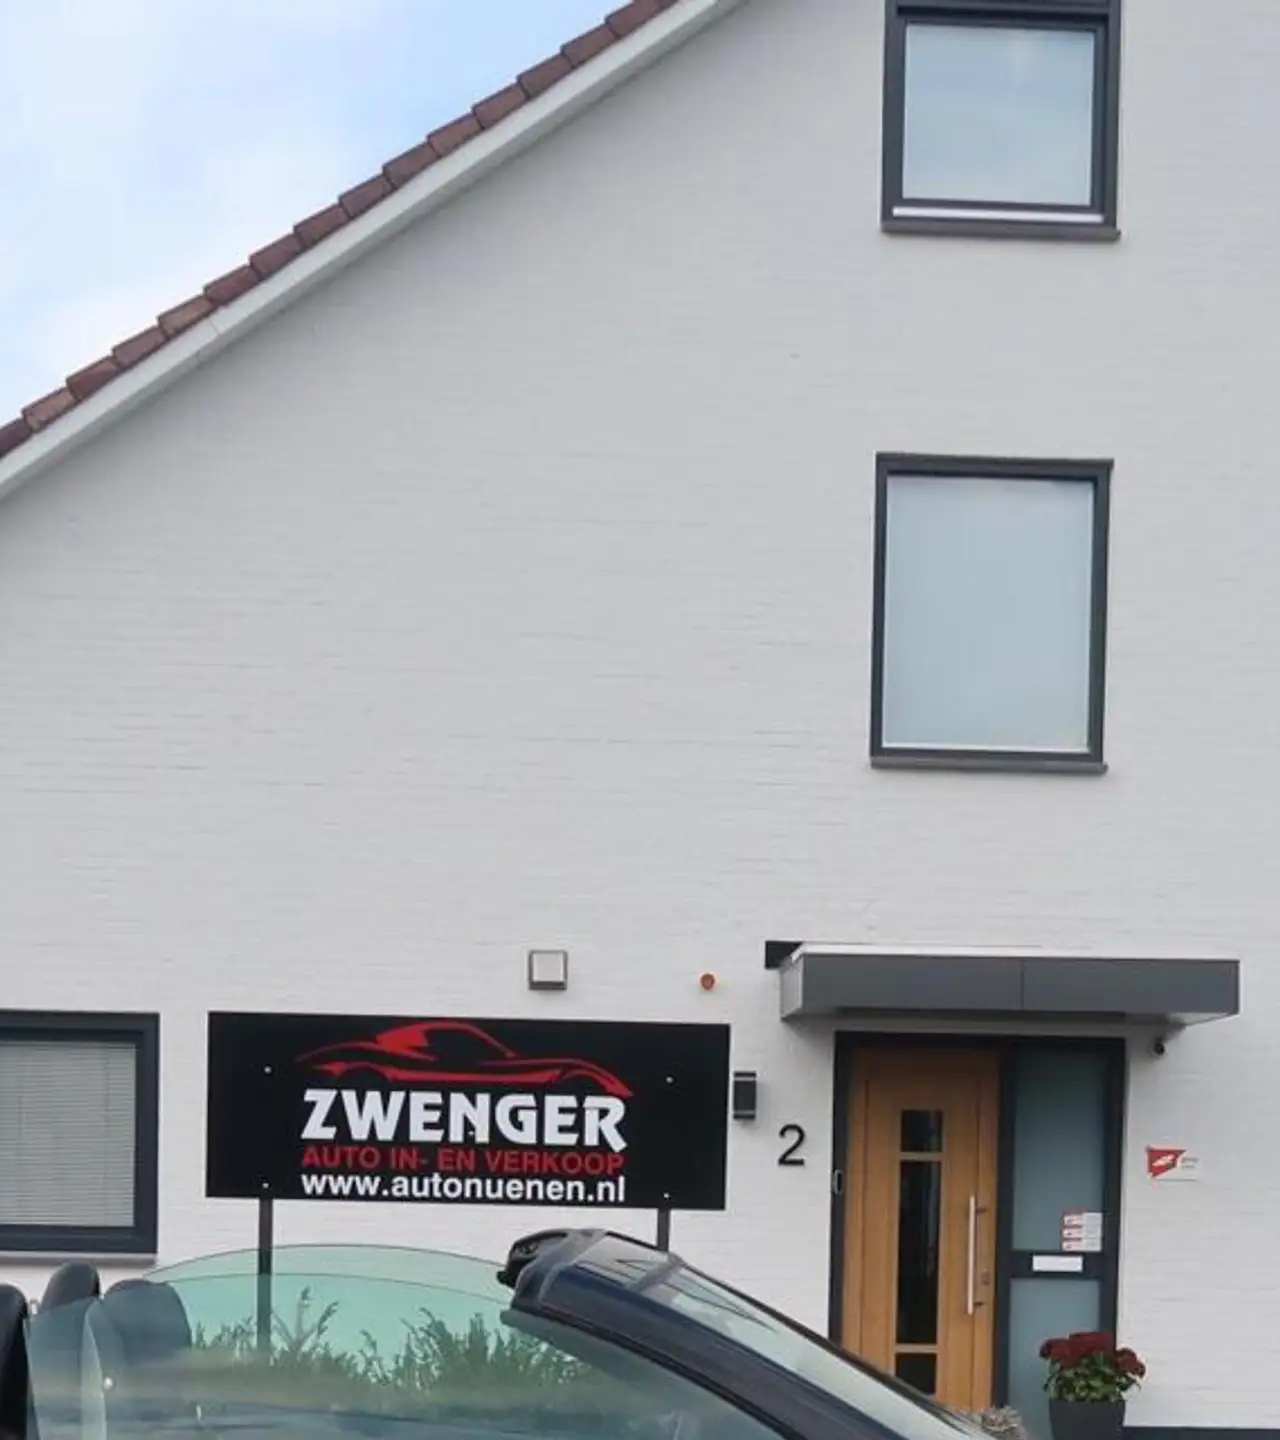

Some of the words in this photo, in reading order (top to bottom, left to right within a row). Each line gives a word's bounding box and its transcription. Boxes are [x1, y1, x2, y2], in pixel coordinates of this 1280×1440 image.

[300, 1088, 628, 1153] ZWENGER
[302, 1144, 381, 1169] AUTO
[390, 1147, 429, 1171] IN-
[437, 1147, 476, 1172] EN
[484, 1150, 625, 1176] VERKOOP
[778, 1124, 805, 1167] 2
[300, 1172, 626, 1203] www.autonuenen.nl
